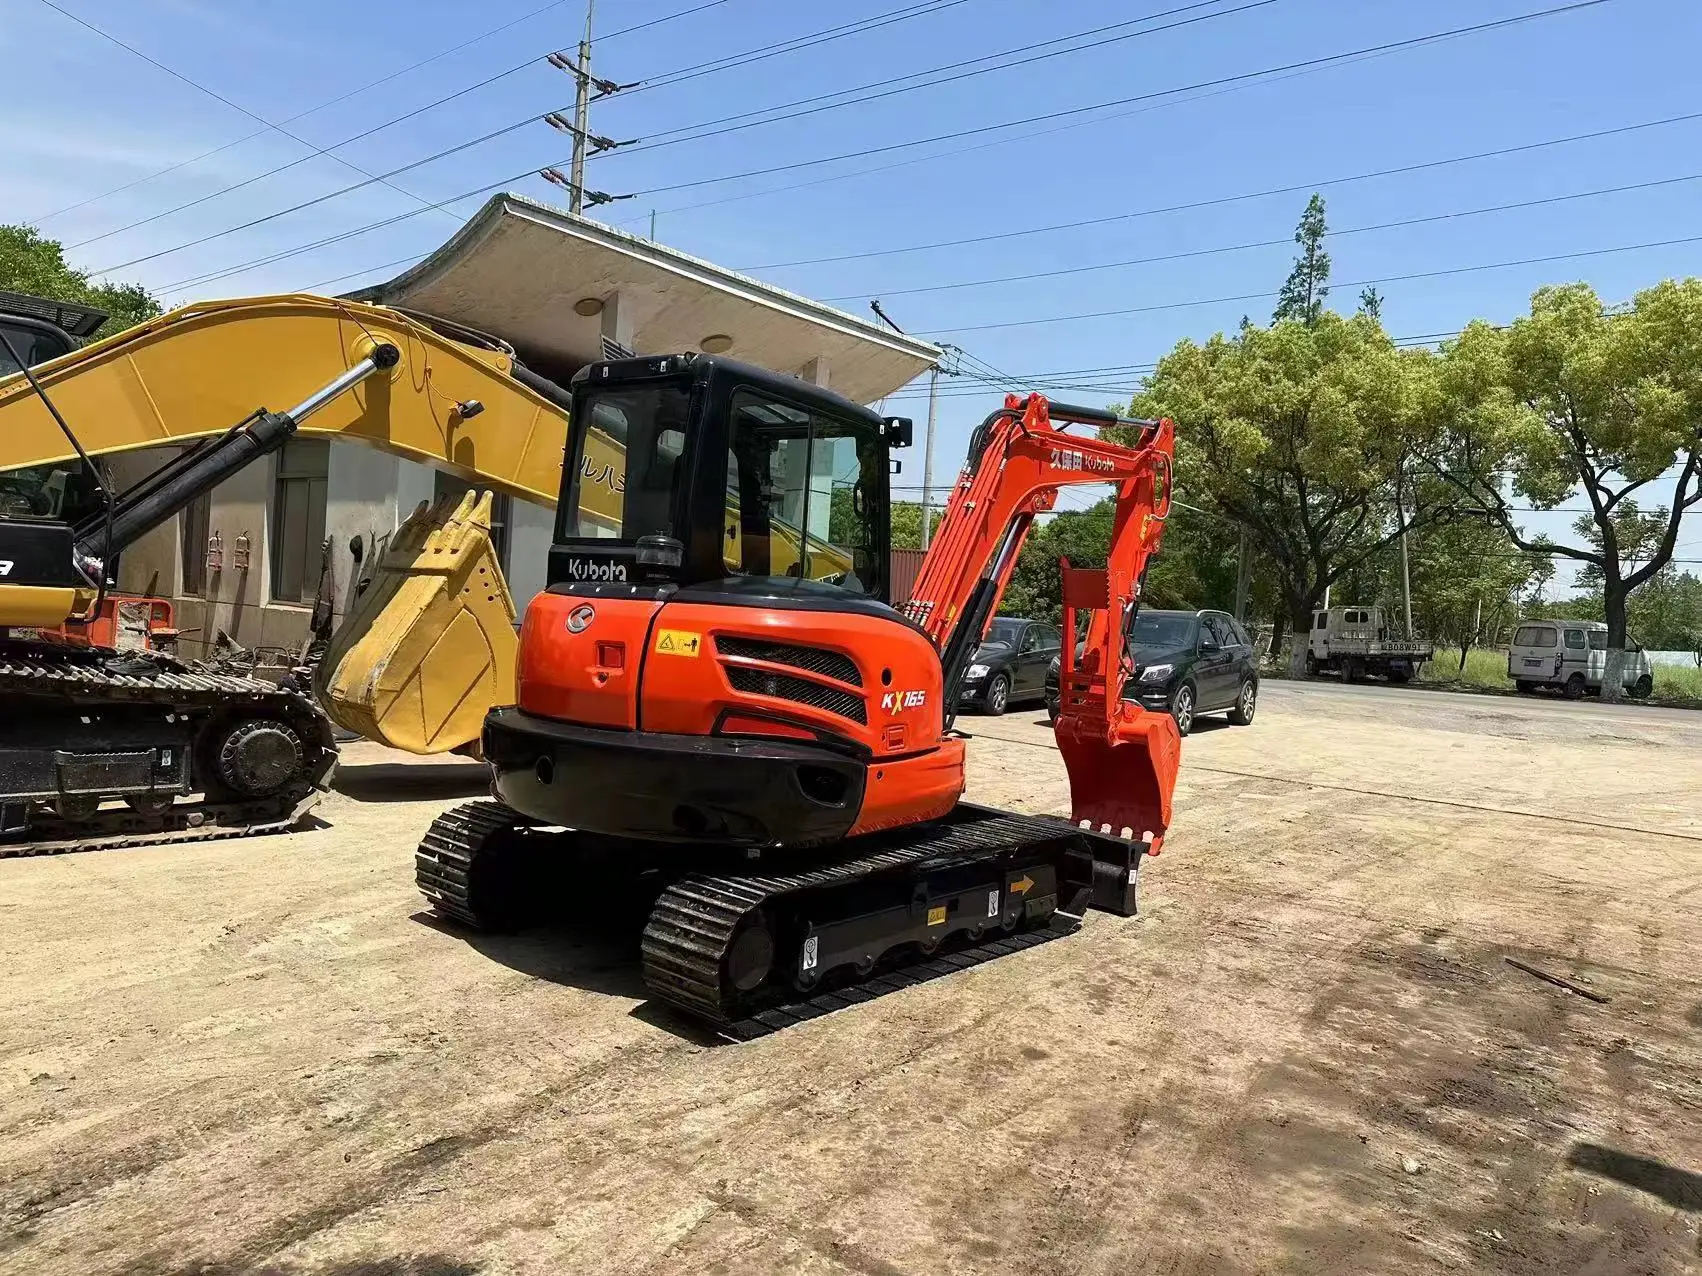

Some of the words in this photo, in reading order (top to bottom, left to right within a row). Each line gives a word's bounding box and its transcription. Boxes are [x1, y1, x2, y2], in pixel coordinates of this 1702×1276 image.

[1050, 447, 1083, 471] 久保田
[1085, 455, 1115, 472] Kubota
[569, 558, 627, 581] Kubota
[881, 690, 926, 716] KX165
